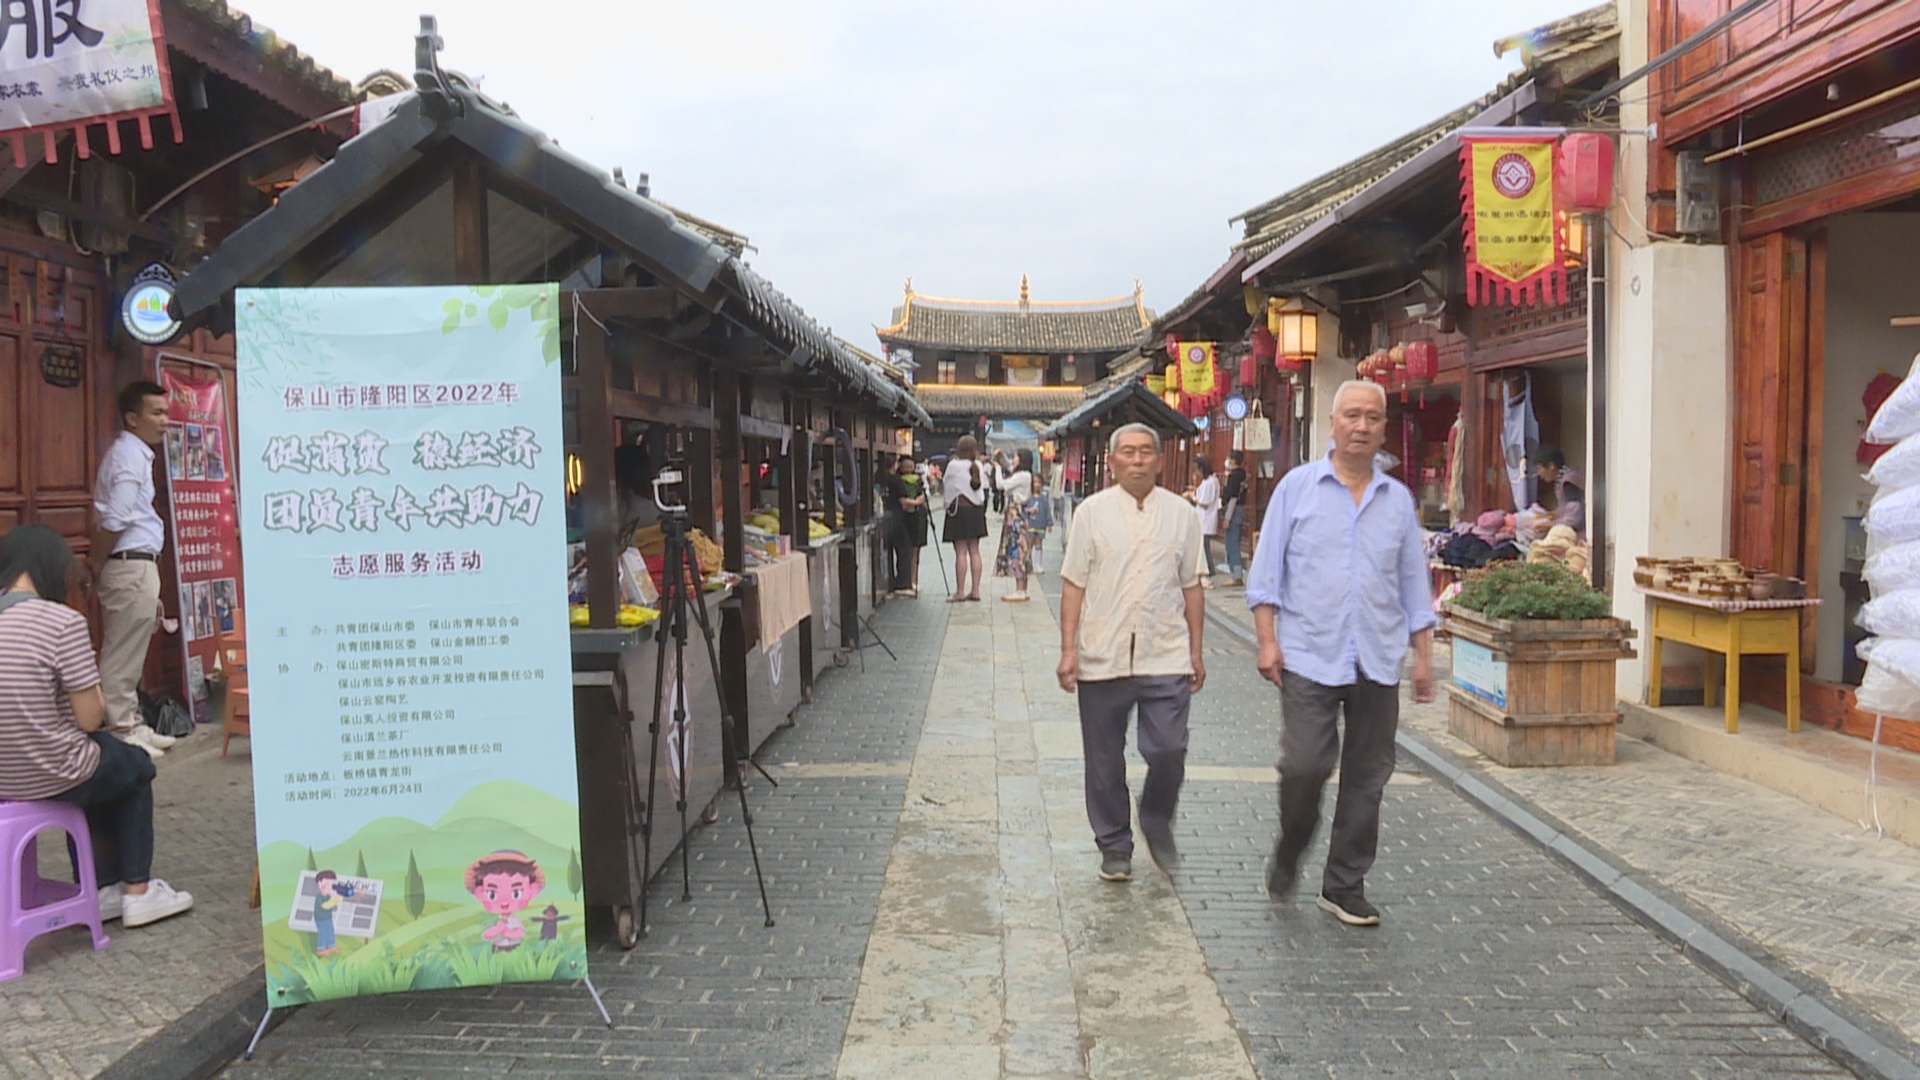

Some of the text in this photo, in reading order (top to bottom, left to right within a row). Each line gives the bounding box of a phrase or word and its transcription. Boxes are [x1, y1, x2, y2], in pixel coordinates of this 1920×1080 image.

[283, 382, 519, 409] 保山市隆阳区2022年
[262, 426, 542, 476] 促消费 稳经济
[262, 482, 544, 535] 团员青年共助力
[331, 550, 482, 577] 志愿服务活动
[428, 615, 520, 631] 保山市青年联合会
[336, 634, 510, 653] 共青团隆阳区委 保山金融团工委
